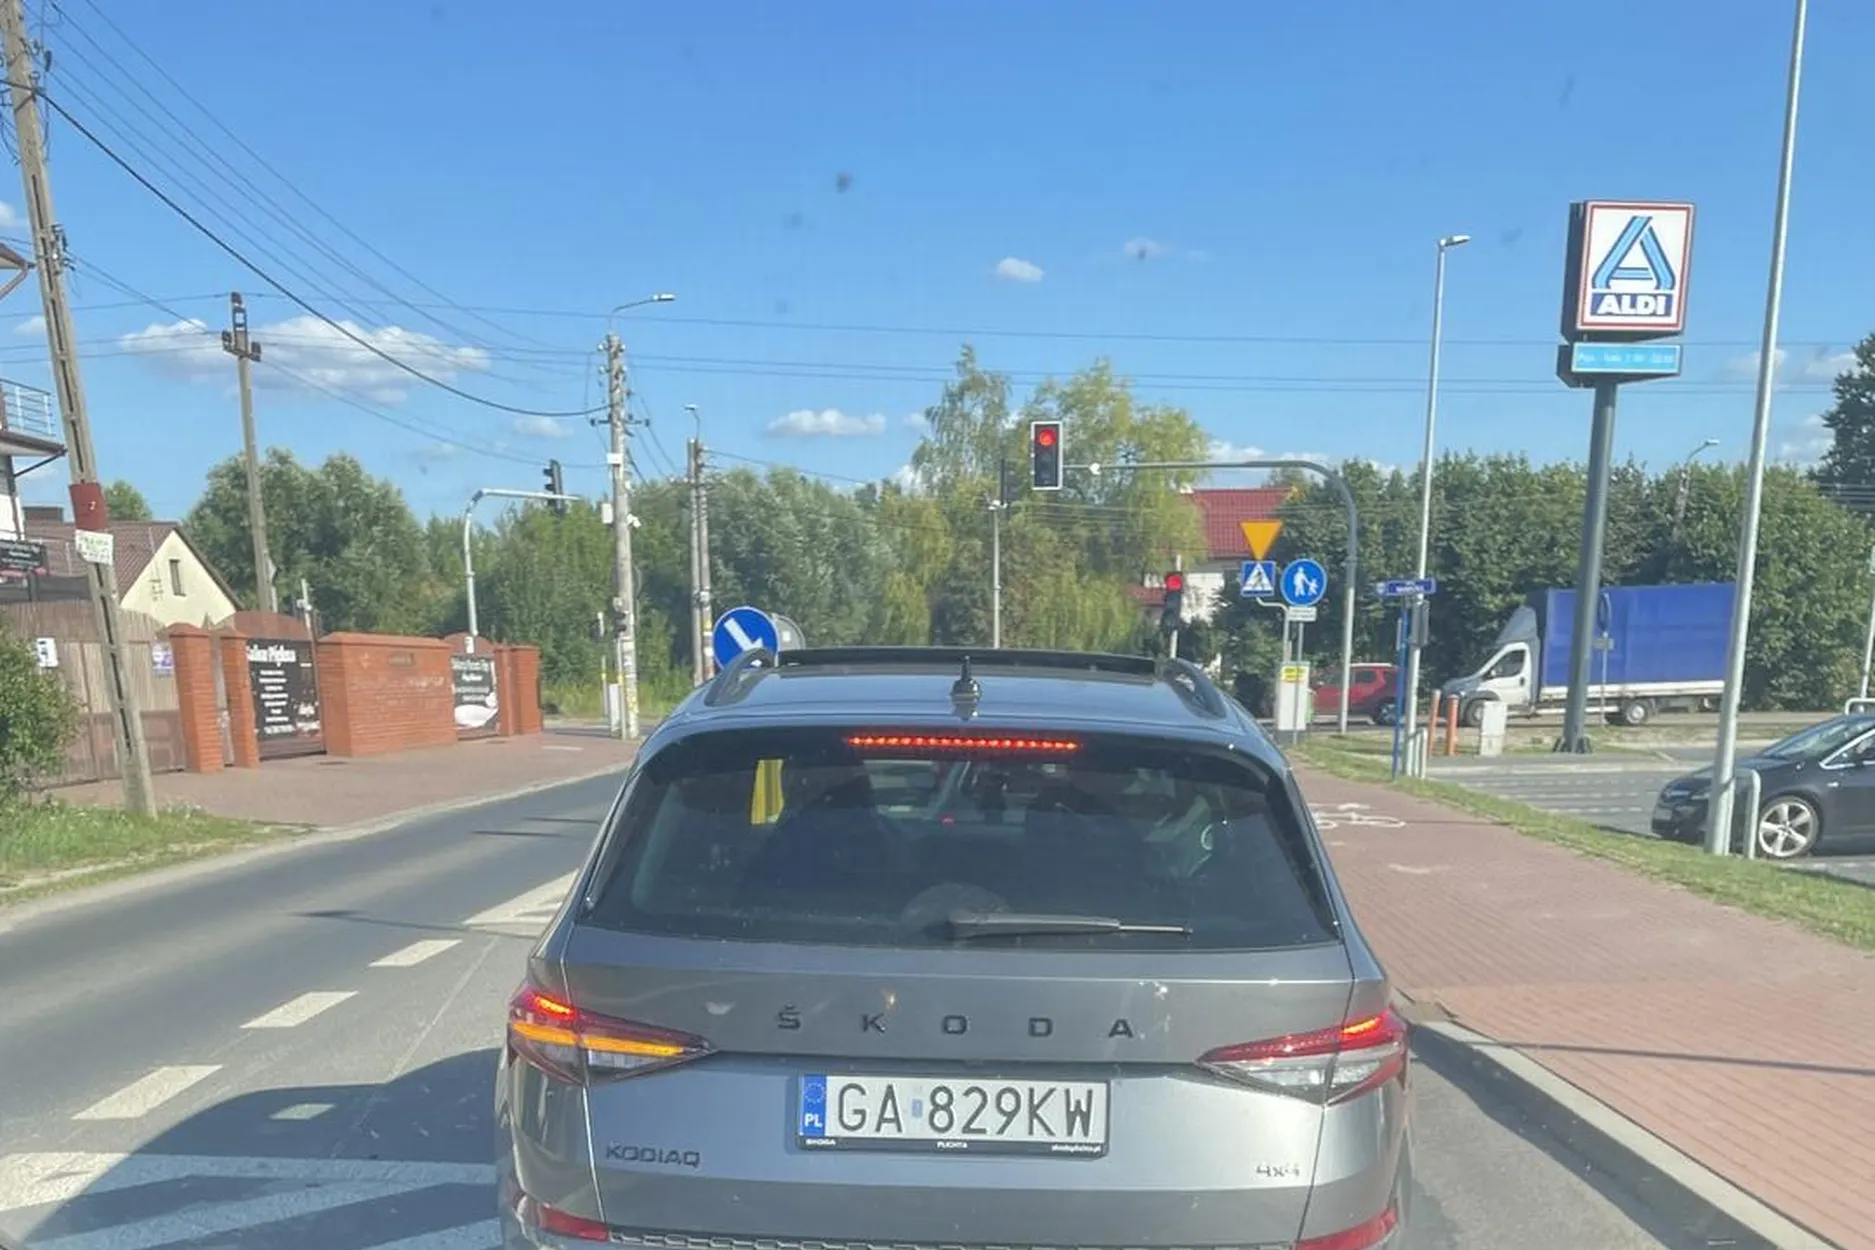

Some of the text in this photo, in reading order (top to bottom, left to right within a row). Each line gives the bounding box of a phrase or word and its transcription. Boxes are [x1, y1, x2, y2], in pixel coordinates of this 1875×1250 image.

[1595, 293, 1668, 316] ALDI
[804, 1112, 823, 1128] PL
[838, 1082, 1094, 1138] GA 829KW
[606, 1145, 701, 1169] KODIAQ
